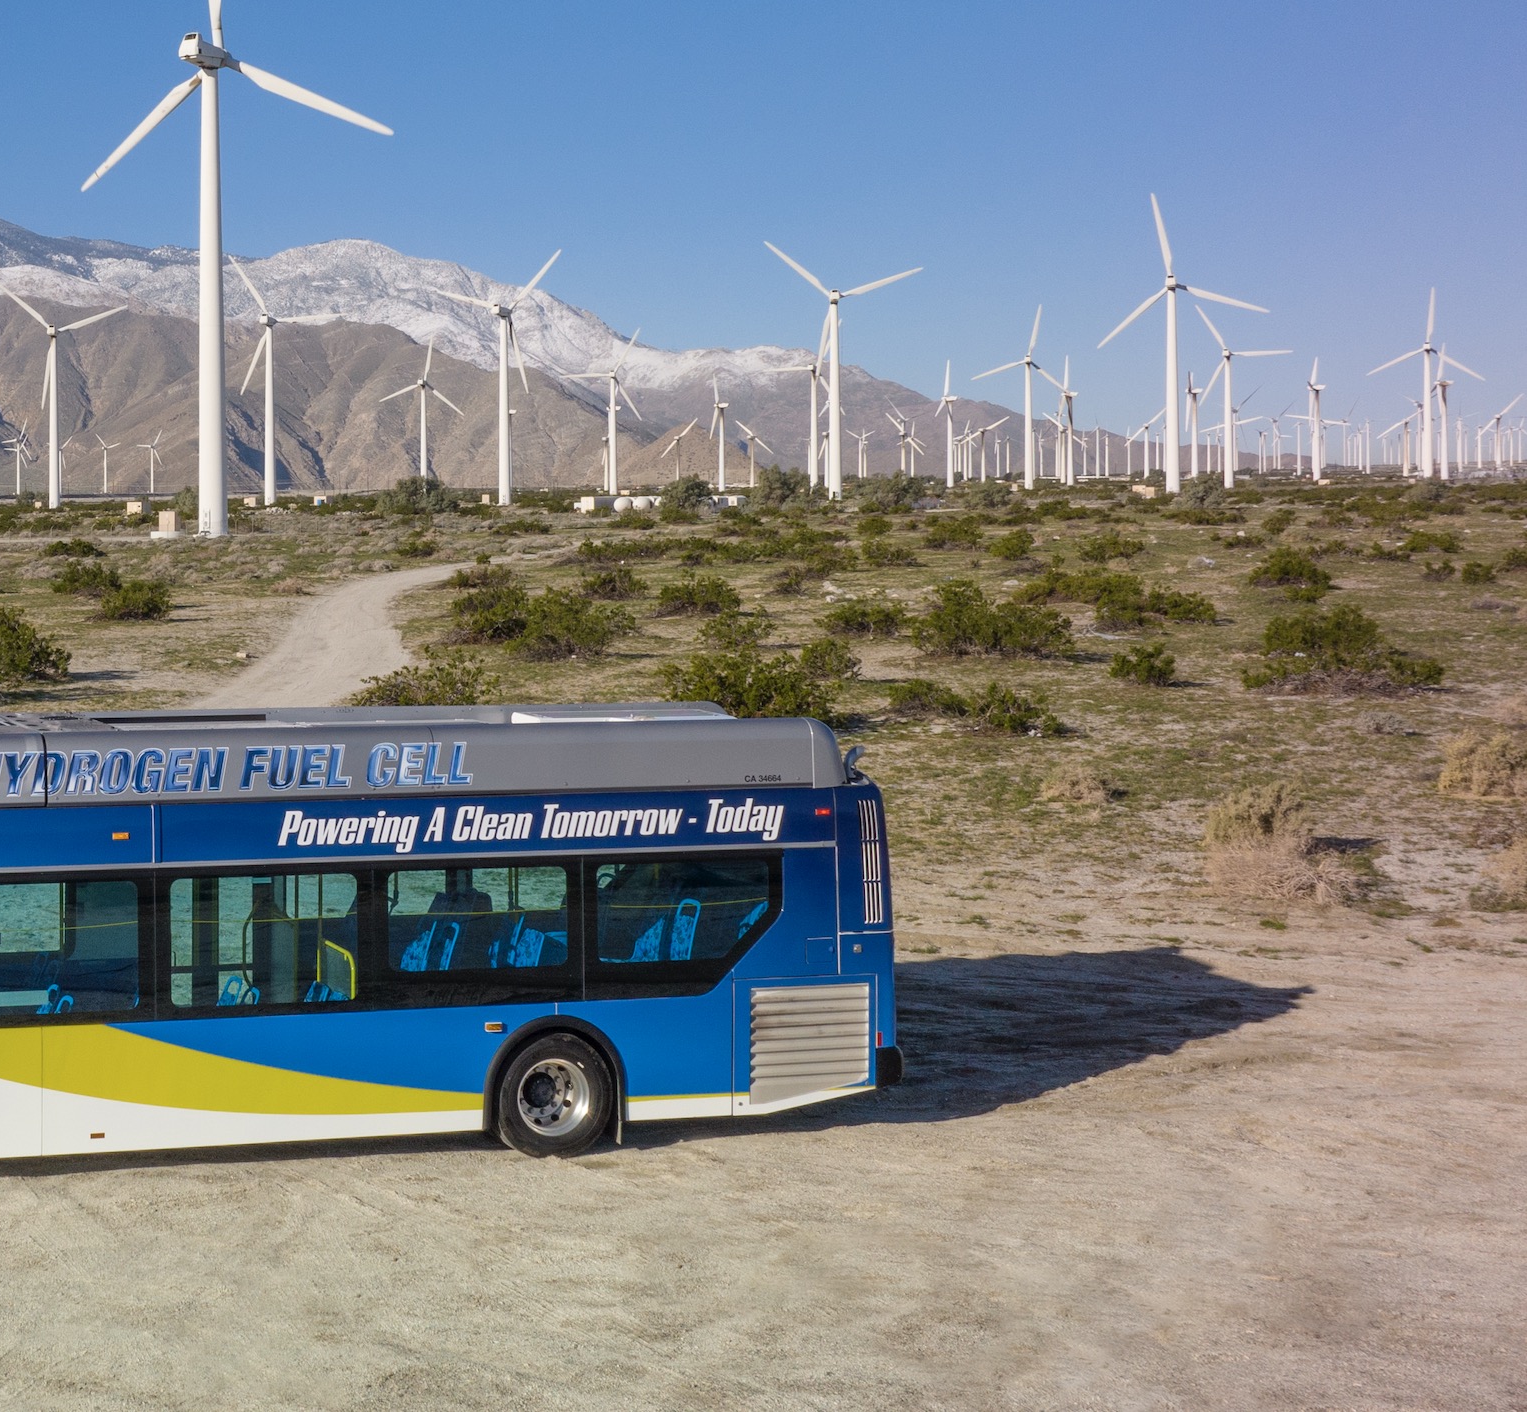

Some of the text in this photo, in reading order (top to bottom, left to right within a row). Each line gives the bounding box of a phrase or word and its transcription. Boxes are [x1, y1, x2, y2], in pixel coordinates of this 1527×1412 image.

[239, 744, 352, 792] FUEL
[365, 741, 474, 789] CELL
[744, 774, 757, 783] CA
[277, 810, 420, 853] Powering
[423, 806, 445, 842] A
[451, 805, 533, 841] Clean
[540, 803, 683, 839] Tomorrow
[705, 798, 784, 841] Today
